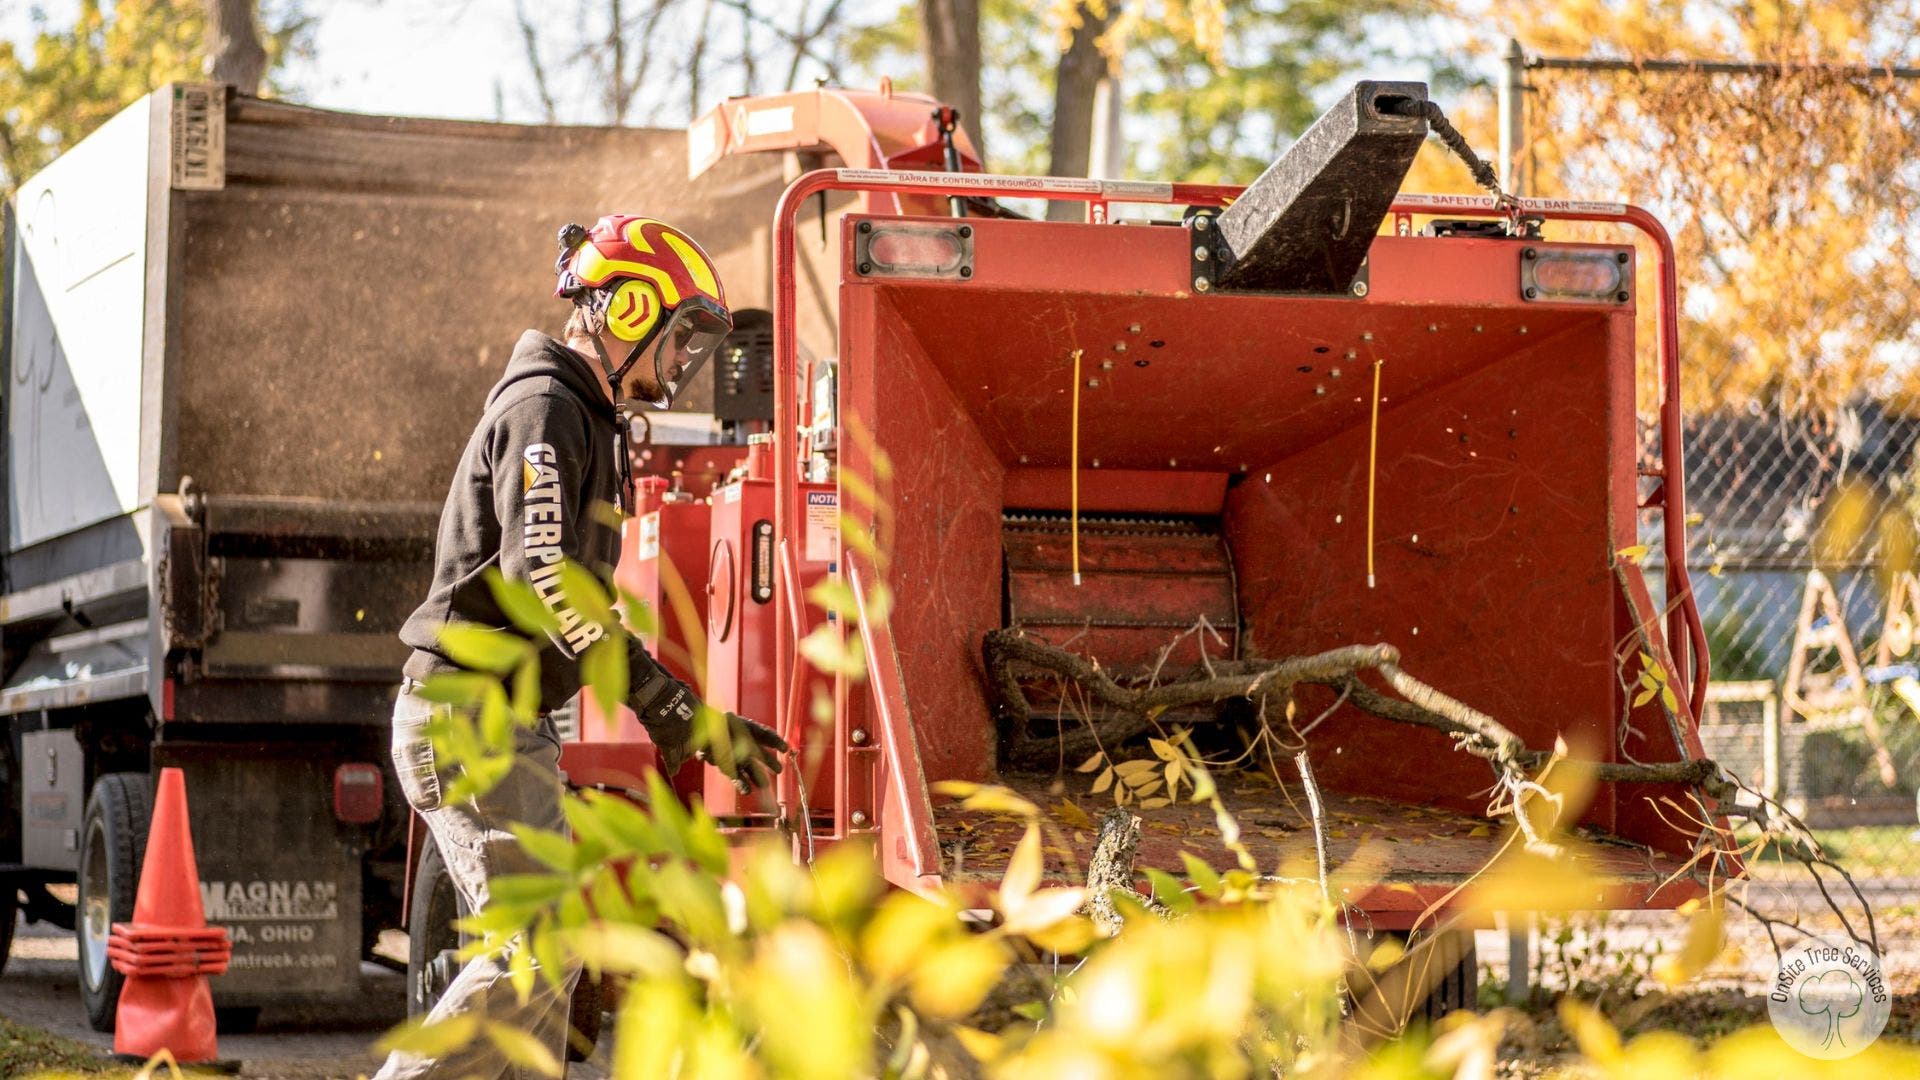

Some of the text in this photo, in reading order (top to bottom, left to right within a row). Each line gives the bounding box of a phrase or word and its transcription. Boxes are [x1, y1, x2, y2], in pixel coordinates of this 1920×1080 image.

[899, 174, 928, 184] BARRA
[929, 176, 942, 184] DE
[942, 176, 981, 186] CONTROL
[983, 178, 995, 186] DE
[996, 178, 1044, 188] SEGURIDAD
[1432, 195, 1479, 206] SAFETY
[1543, 200, 1570, 210] BAR
[810, 494, 837, 504] NOTI
[260, 925, 314, 943] OHIO
[228, 952, 337, 968] mtruck.com
